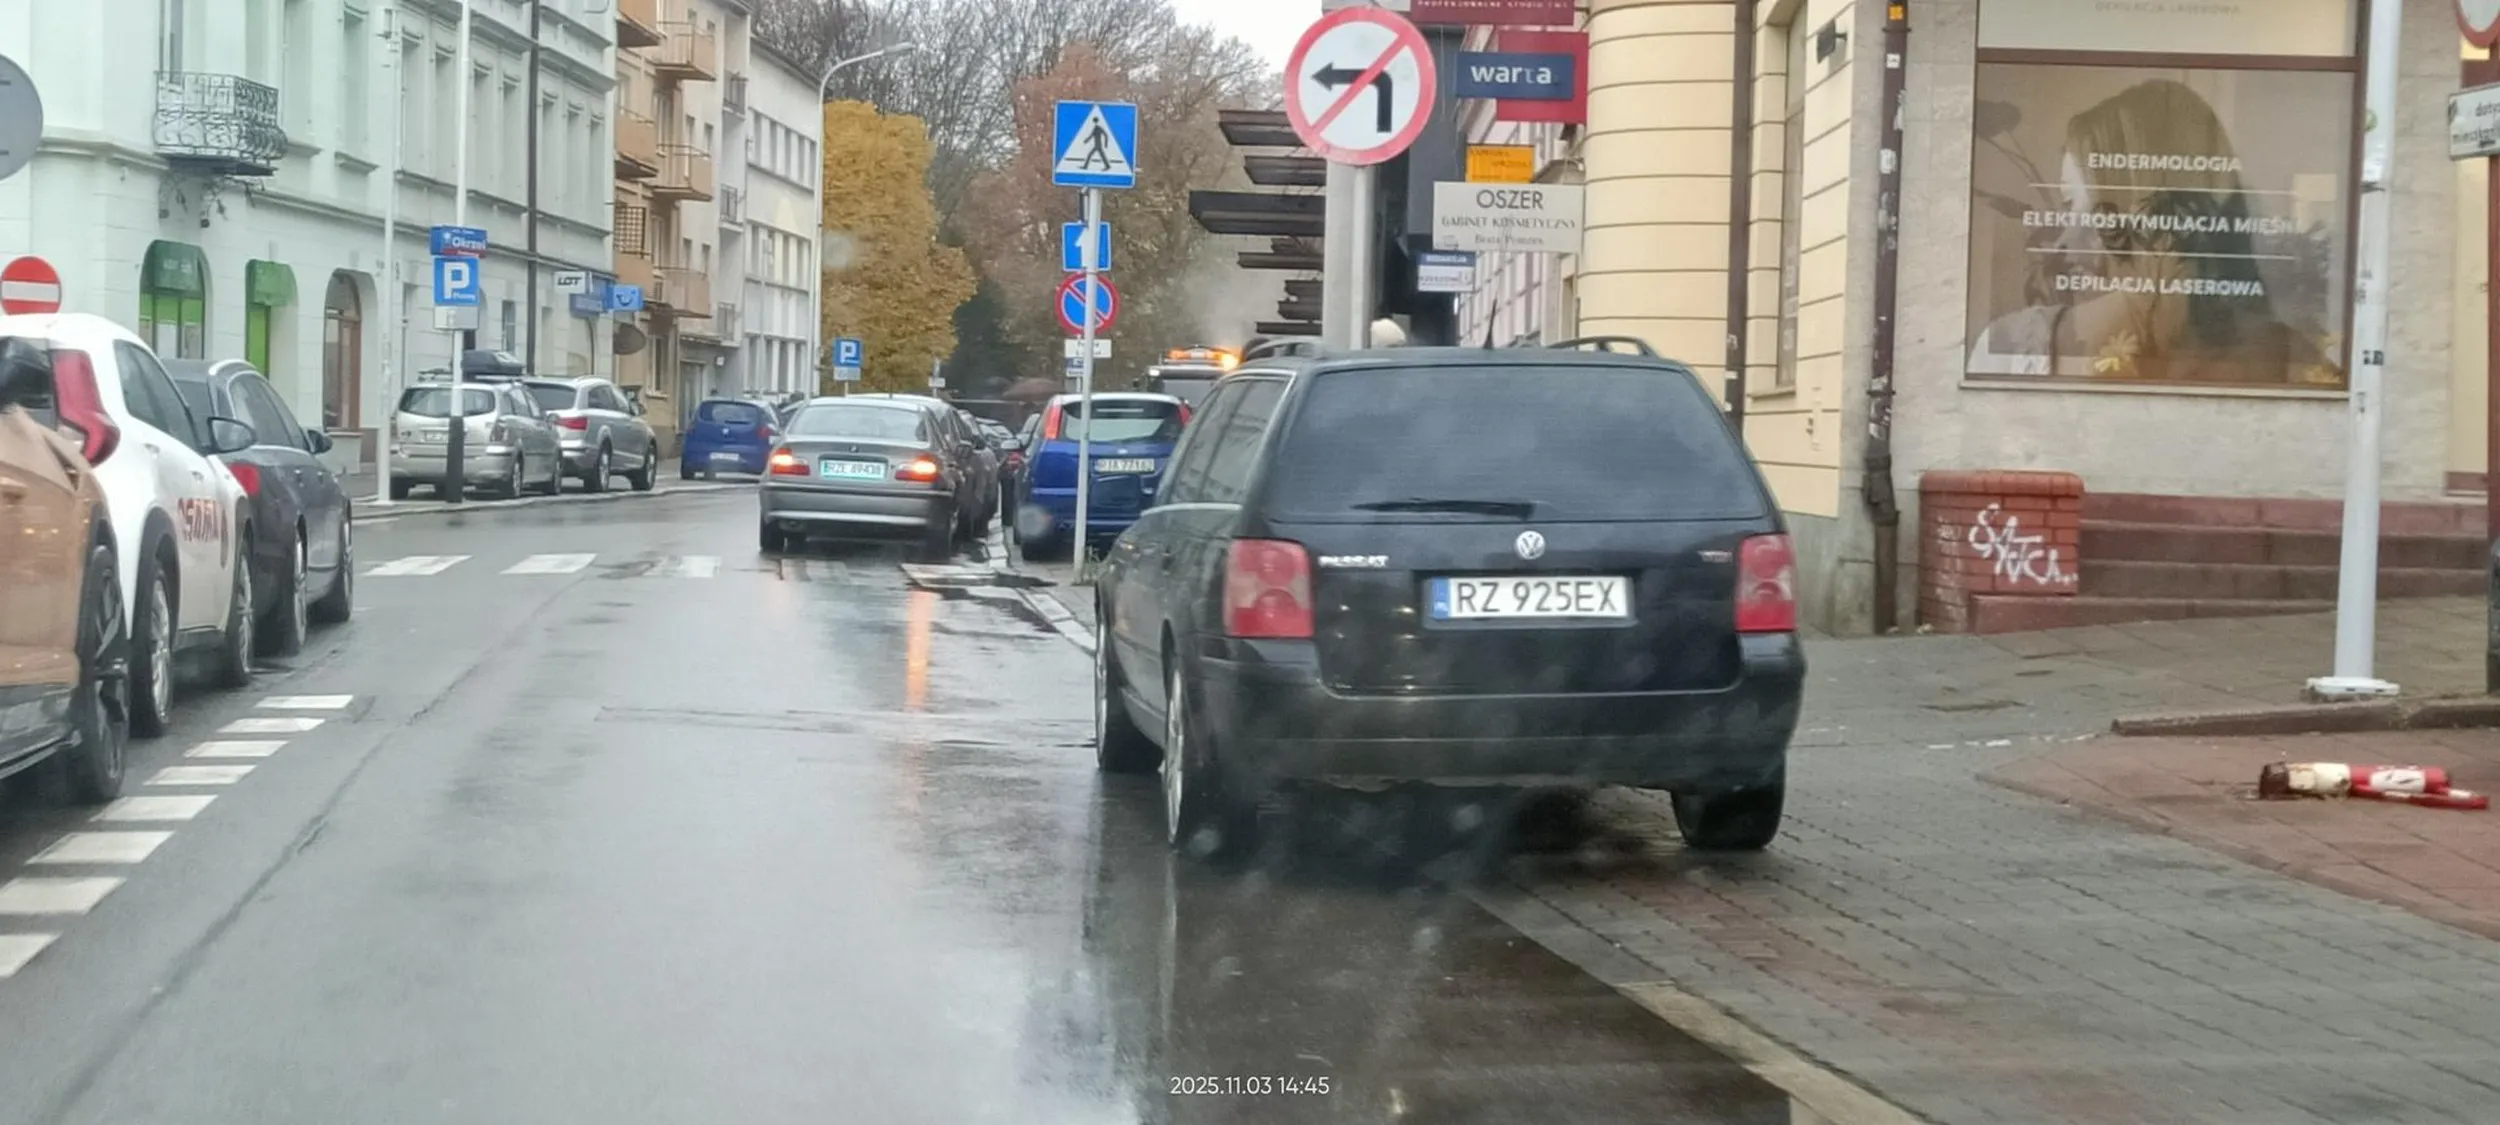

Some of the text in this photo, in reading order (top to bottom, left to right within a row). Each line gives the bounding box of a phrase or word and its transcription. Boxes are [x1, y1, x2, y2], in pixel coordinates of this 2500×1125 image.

[1470, 65, 1552, 84] warta
[2088, 152, 2243, 172] ENDERMOLOGIA
[1476, 189, 1544, 209] OSZER
[1441, 216, 1576, 229] GABINET KOSMETYCZNY
[2022, 210, 2231, 232] ELEKTROSTYMULACJA
[443, 261, 470, 300] P
[557, 276, 583, 286] LOT
[2056, 274, 2264, 297] DEPILACJA LASEROWA
[840, 341, 857, 364] P
[1457, 581, 1617, 612] RZ 925EX
